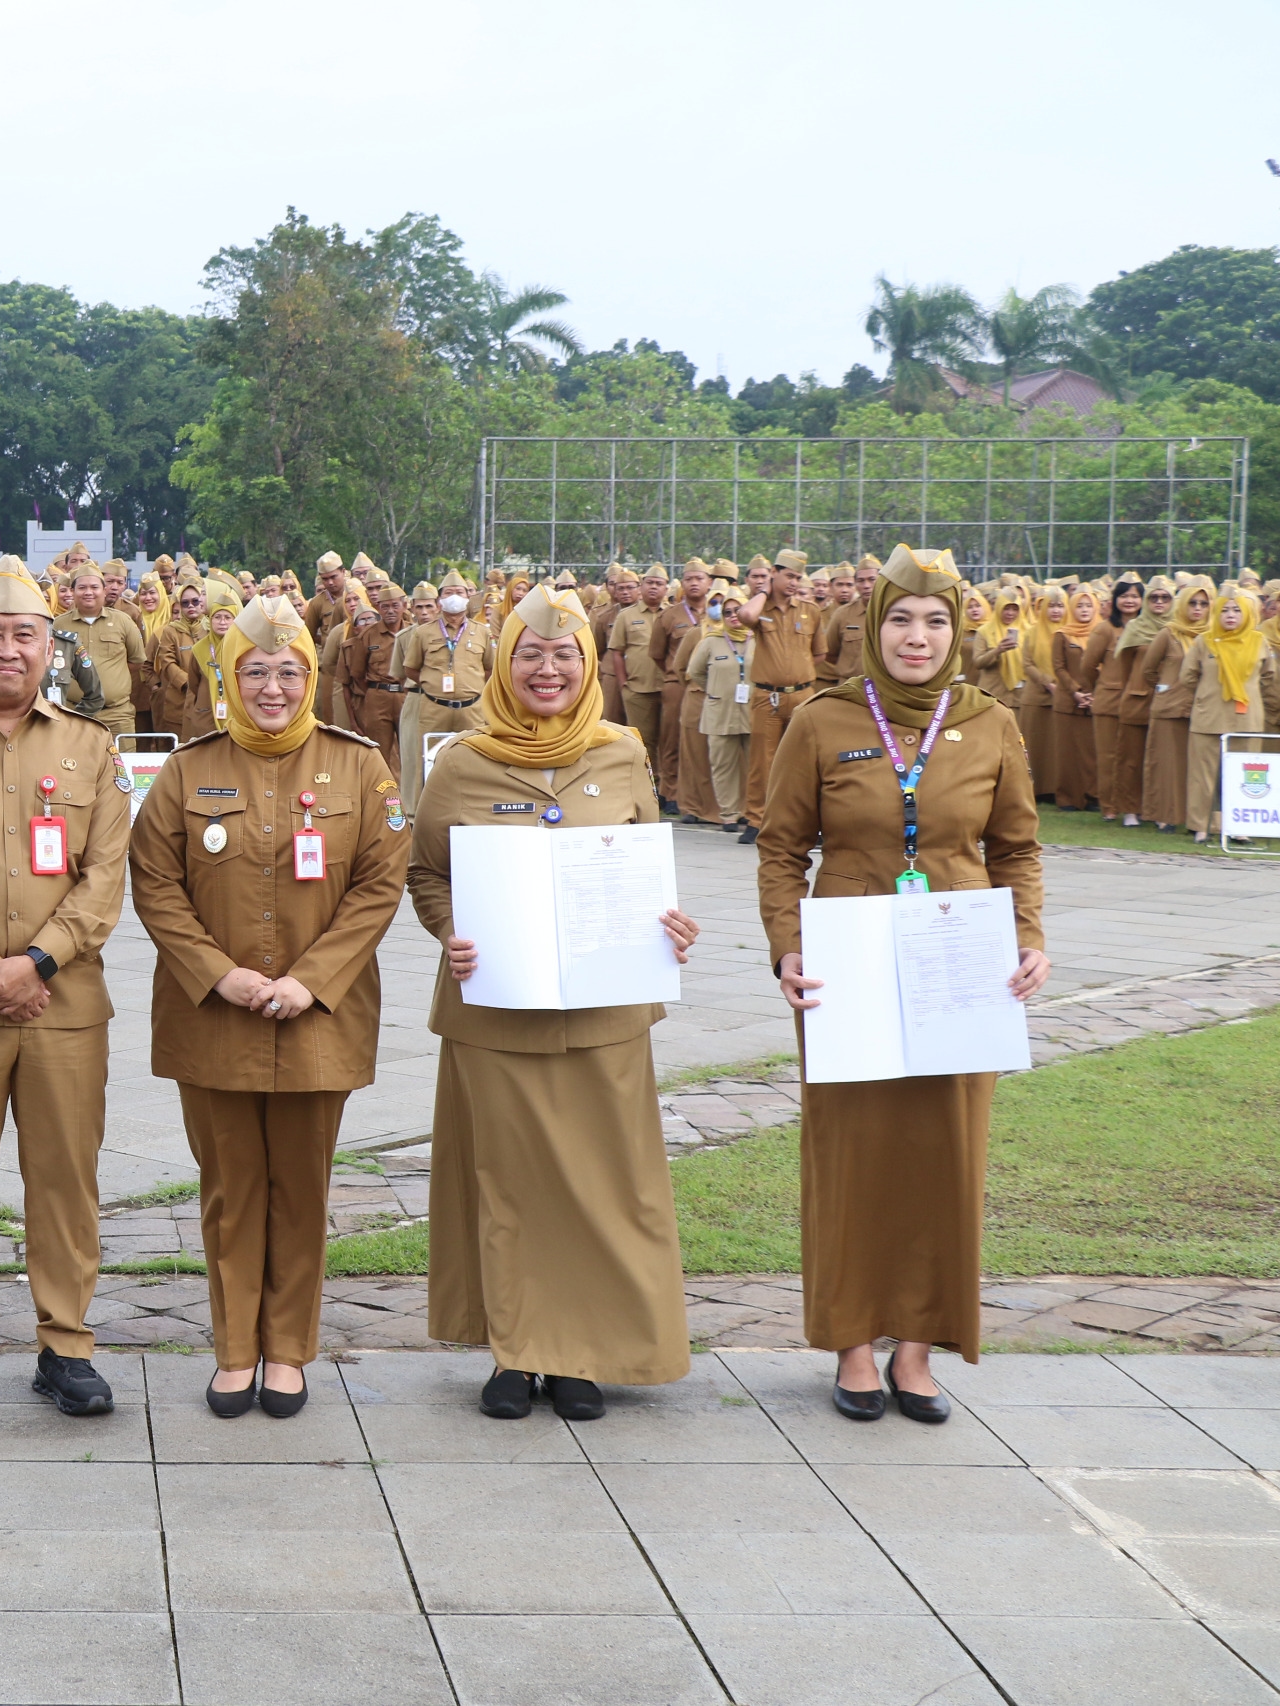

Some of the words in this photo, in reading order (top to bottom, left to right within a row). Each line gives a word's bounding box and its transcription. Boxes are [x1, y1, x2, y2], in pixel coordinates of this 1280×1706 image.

[920, 719, 941, 754] TANGERANG
[847, 749, 872, 758] JULE
[1232, 807, 1280, 823] SETDA
